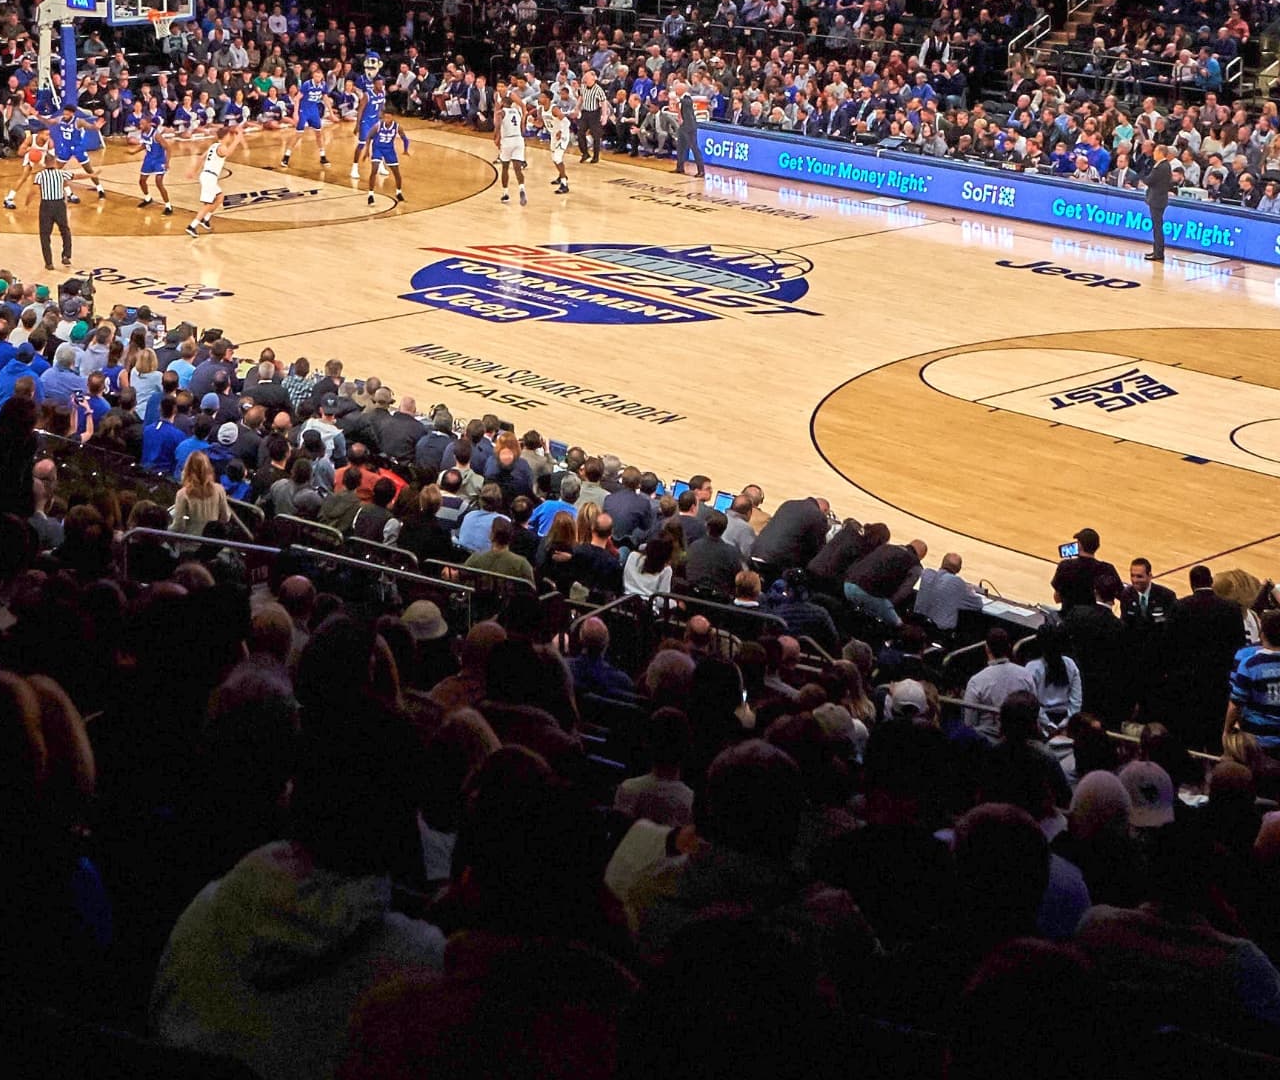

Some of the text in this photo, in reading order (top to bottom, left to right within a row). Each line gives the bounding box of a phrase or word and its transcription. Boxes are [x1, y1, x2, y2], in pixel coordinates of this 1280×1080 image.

[510, 115, 518, 127] 4
[629, 194, 718, 214] CHASE
[704, 138, 734, 160] SoFi
[778, 152, 803, 170] Get
[806, 157, 837, 177] Your
[838, 161, 886, 189] Money
[961, 181, 997, 205] SoFi
[1052, 198, 1083, 220] Get
[1086, 203, 1123, 225] Your
[1124, 209, 1183, 245] Moey
[75, 267, 167, 290] SoFi
[446, 261, 694, 321] TOURNAMENT
[467, 244, 825, 317] BIG EAST
[995, 260, 1141, 289] Jeep
[424, 287, 531, 322] Jeep
[399, 343, 687, 425] MADISON SQUARE GARDEN
[427, 375, 548, 411] CHASE
[1094, 384, 1179, 413] BIG
